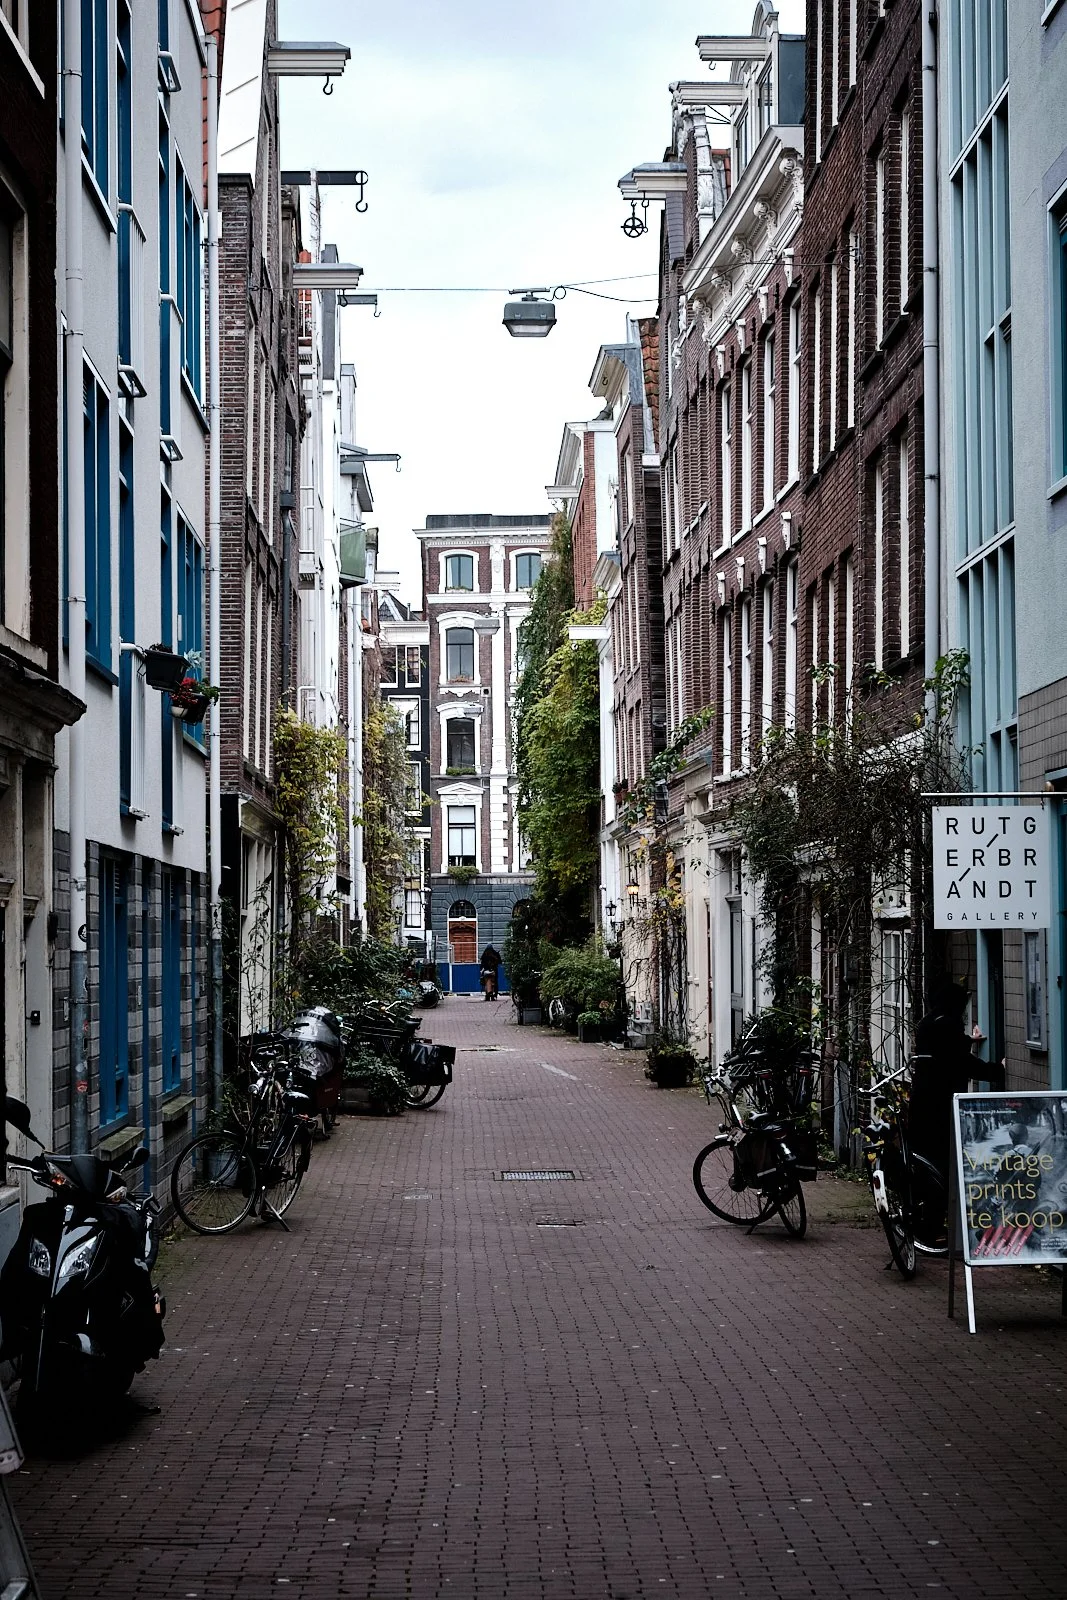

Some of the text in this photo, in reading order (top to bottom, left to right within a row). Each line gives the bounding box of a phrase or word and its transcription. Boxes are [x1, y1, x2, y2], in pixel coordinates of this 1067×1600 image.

[946, 816, 1037, 835] RUTG
[946, 848, 1037, 867] ERBR
[946, 880, 1037, 899] ANDT
[946, 911, 1038, 921] GALLERY
[963, 1147, 1054, 1178] Vintage
[967, 1179, 1037, 1207] prints
[966, 1205, 1064, 1235] te koop
